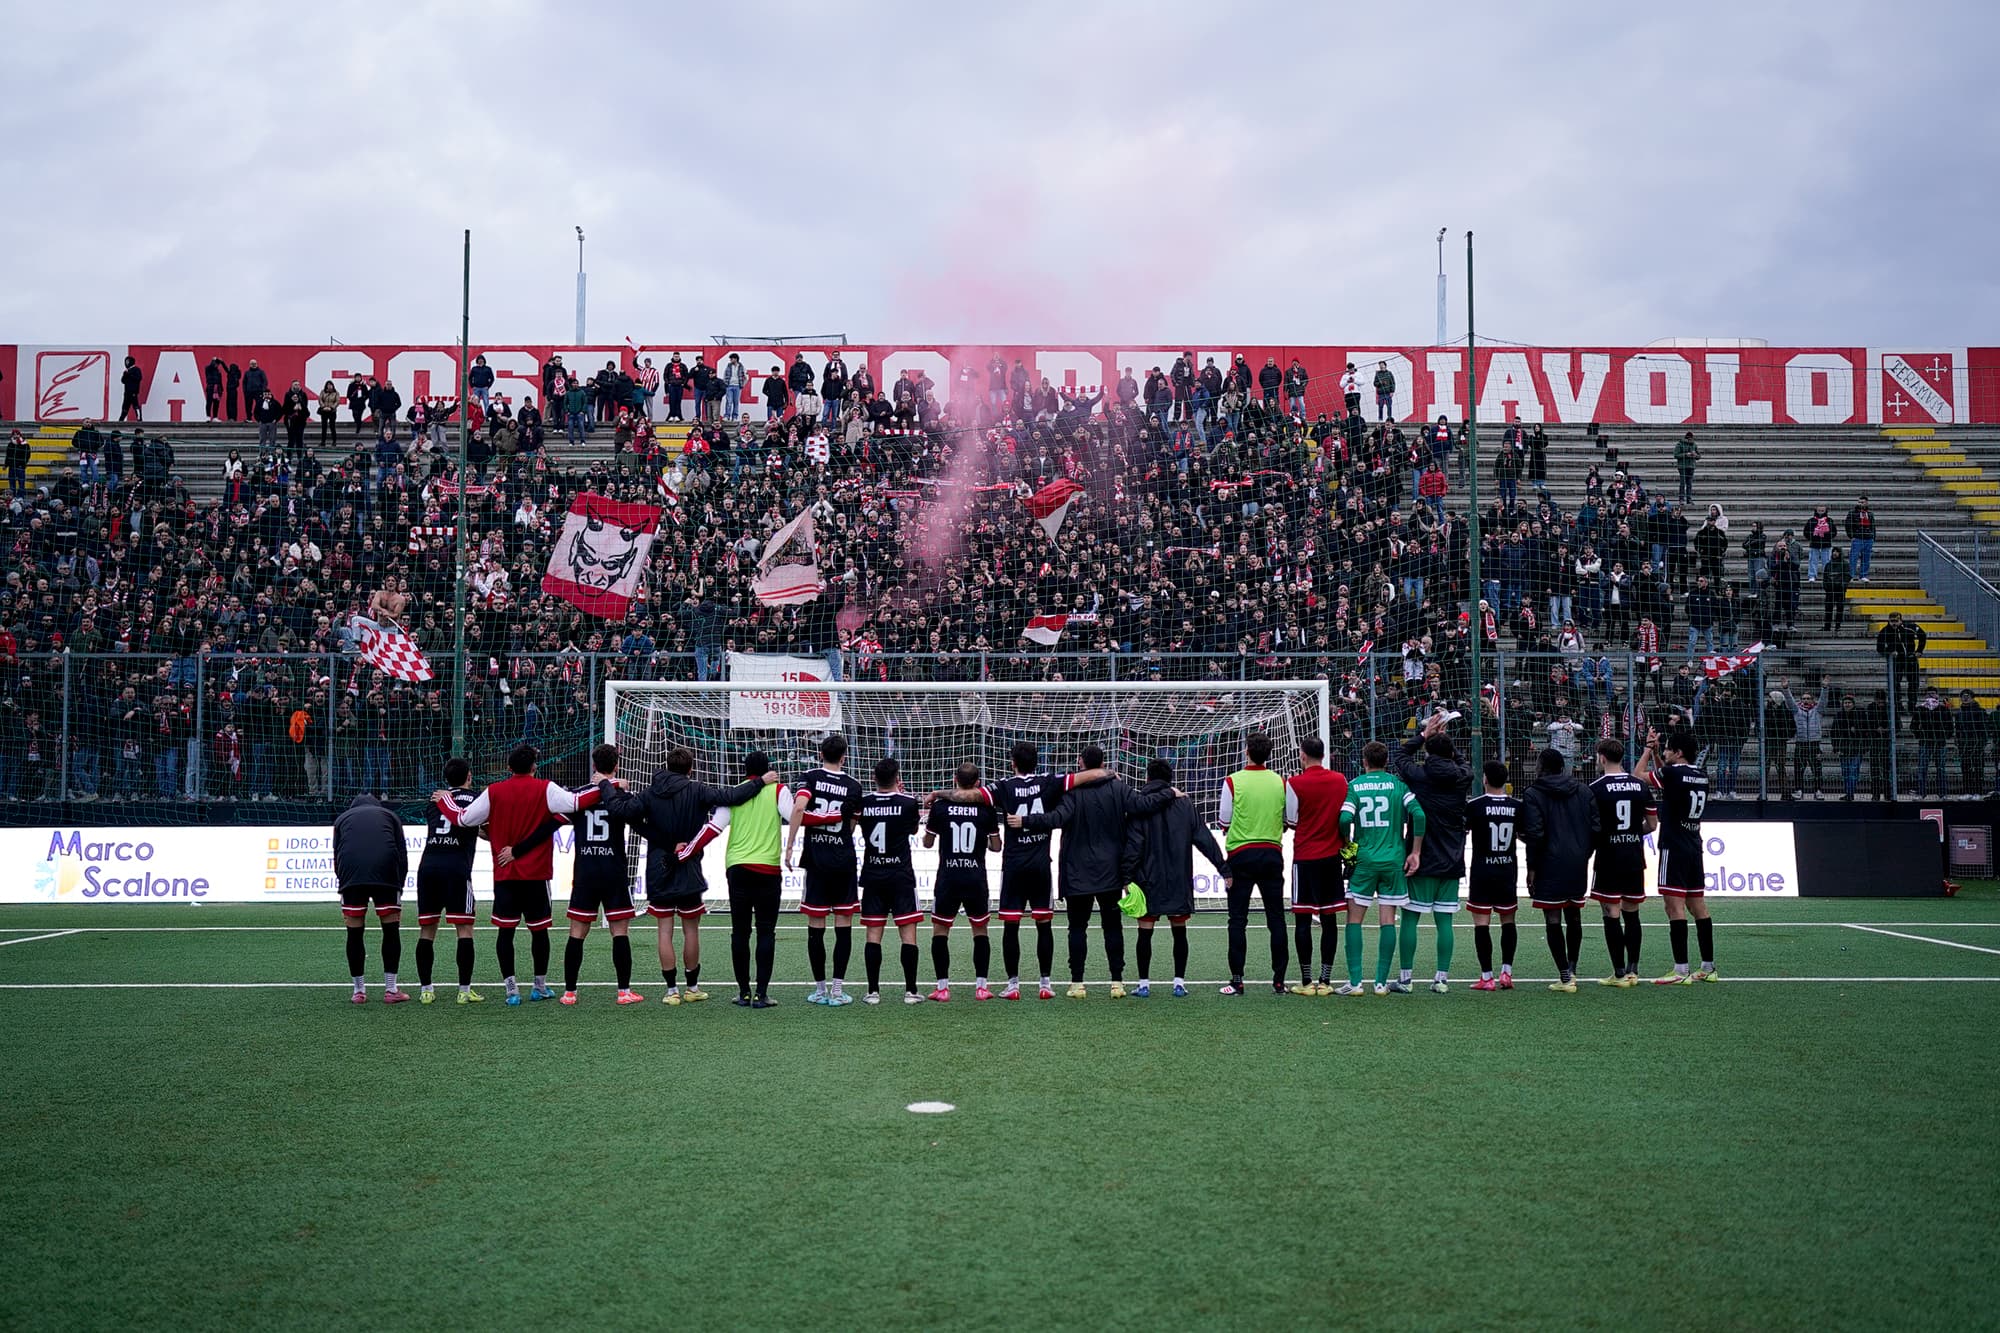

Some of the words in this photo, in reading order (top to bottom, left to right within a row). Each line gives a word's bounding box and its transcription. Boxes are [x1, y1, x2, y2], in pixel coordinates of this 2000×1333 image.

[142, 351, 216, 422] A
[1345, 351, 1854, 424] DIAVOLO
[763, 702, 797, 715] 1913
[815, 780, 848, 796] BOTRINI
[1606, 782, 1642, 793] PERSANO
[863, 805, 902, 816] ANGIULLI
[948, 805, 978, 817] SERENI
[1359, 795, 1390, 828] 22
[1485, 806, 1516, 817] PAVONE
[1616, 799, 1631, 830] 9
[1688, 790, 1706, 819] 13
[584, 809, 610, 841] 15
[869, 821, 887, 853] 4
[949, 821, 977, 854] 10
[1488, 821, 1514, 852] 19
[46, 830, 154, 861] Marco
[580, 846, 614, 856] HATRIA
[1610, 834, 1641, 844] HATRIA
[946, 858, 979, 868] HATRIA
[81, 866, 210, 898] Scalone
[1704, 866, 1785, 892] alone
